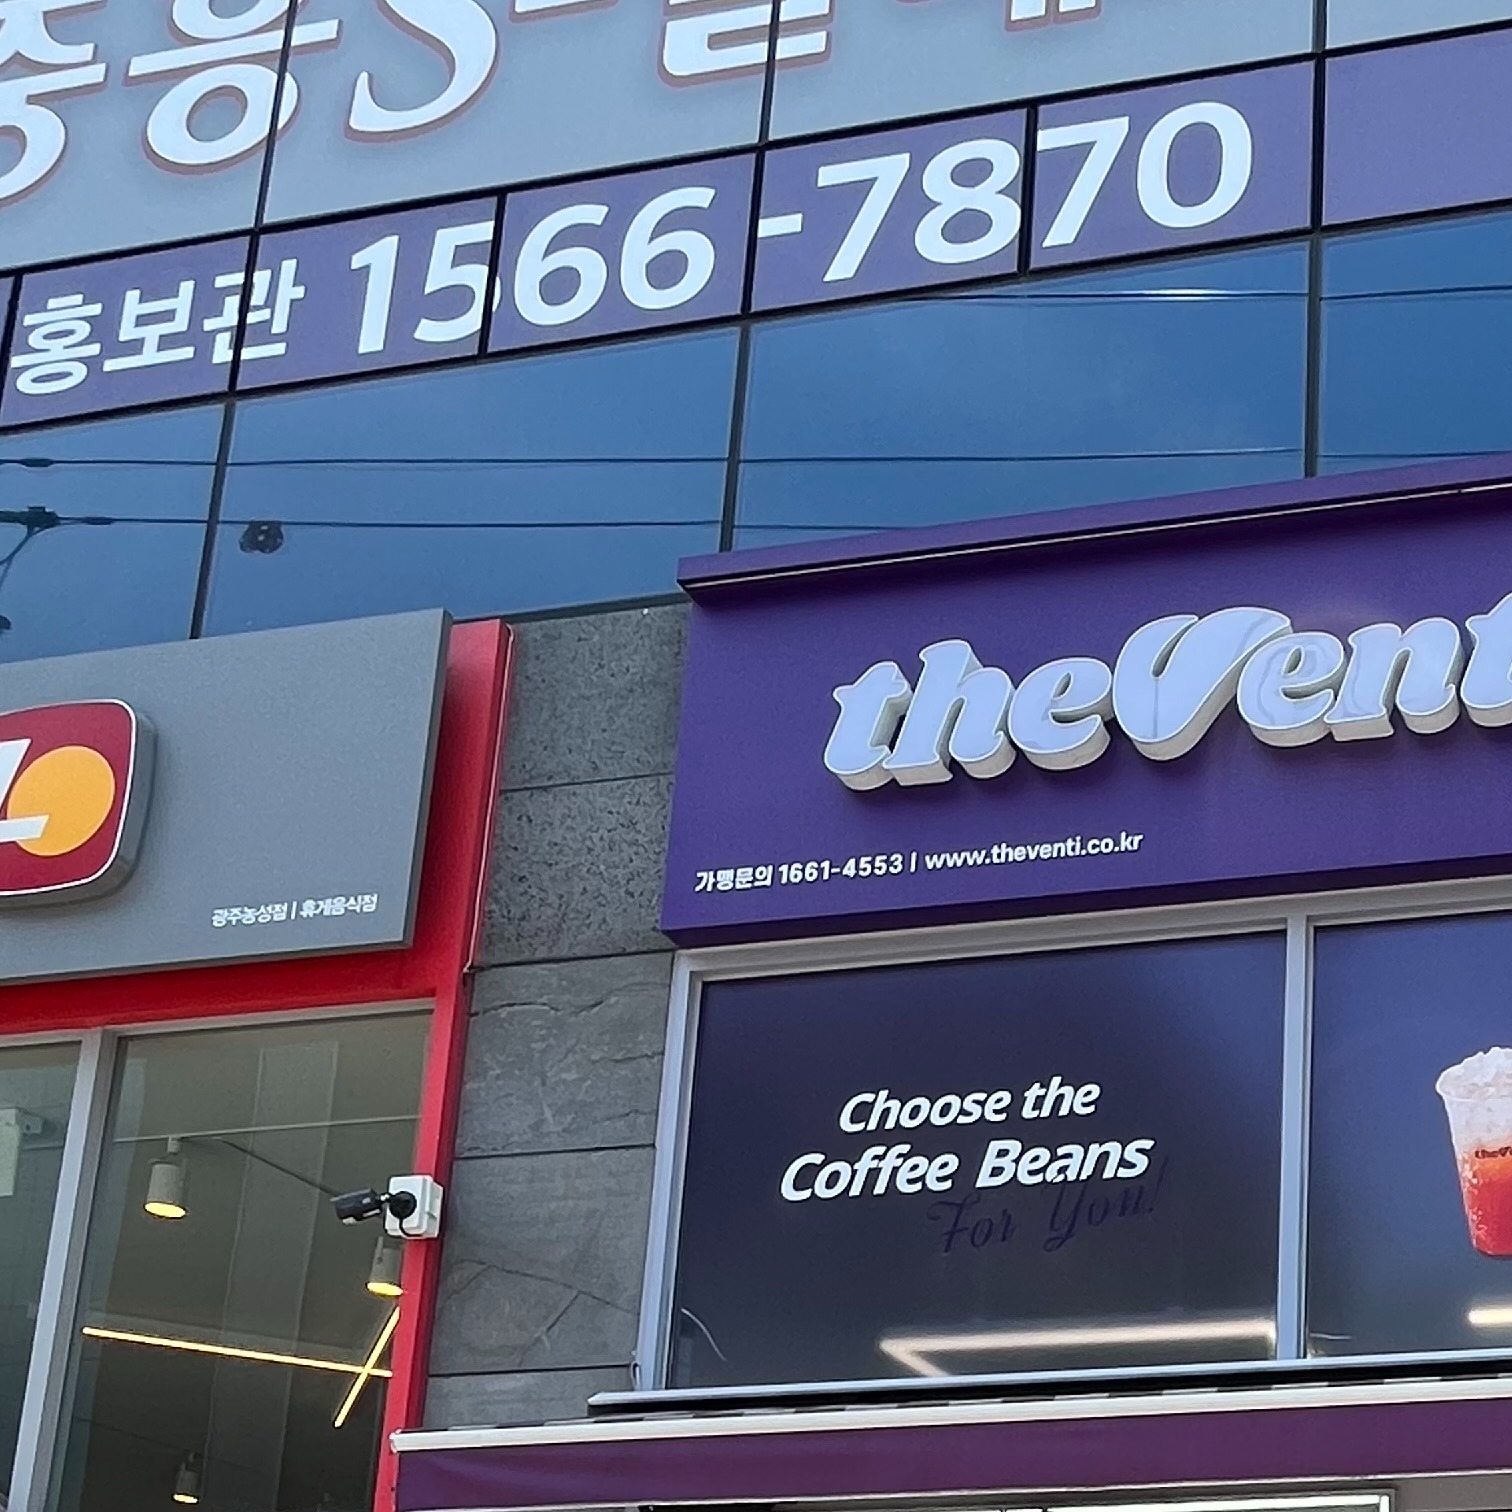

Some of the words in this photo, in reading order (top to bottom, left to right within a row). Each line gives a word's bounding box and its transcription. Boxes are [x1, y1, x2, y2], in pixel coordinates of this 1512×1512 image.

[11, 259, 305, 395] 홍보관
[350, 102, 1252, 355] 1566-7870
[695, 863, 774, 894] 가맹문의
[778, 853, 904, 886] 1661-4553
[924, 831, 1143, 873] www.theventi.co.kr
[211, 902, 288, 928] 광주농성점
[300, 893, 378, 919] 휴게음식점
[839, 1089, 1012, 1134] Choose
[1020, 1076, 1101, 1119] the
[780, 1143, 960, 1202] Coffee
[975, 1137, 1156, 1189] Beans
[926, 1194, 1017, 1254] For
